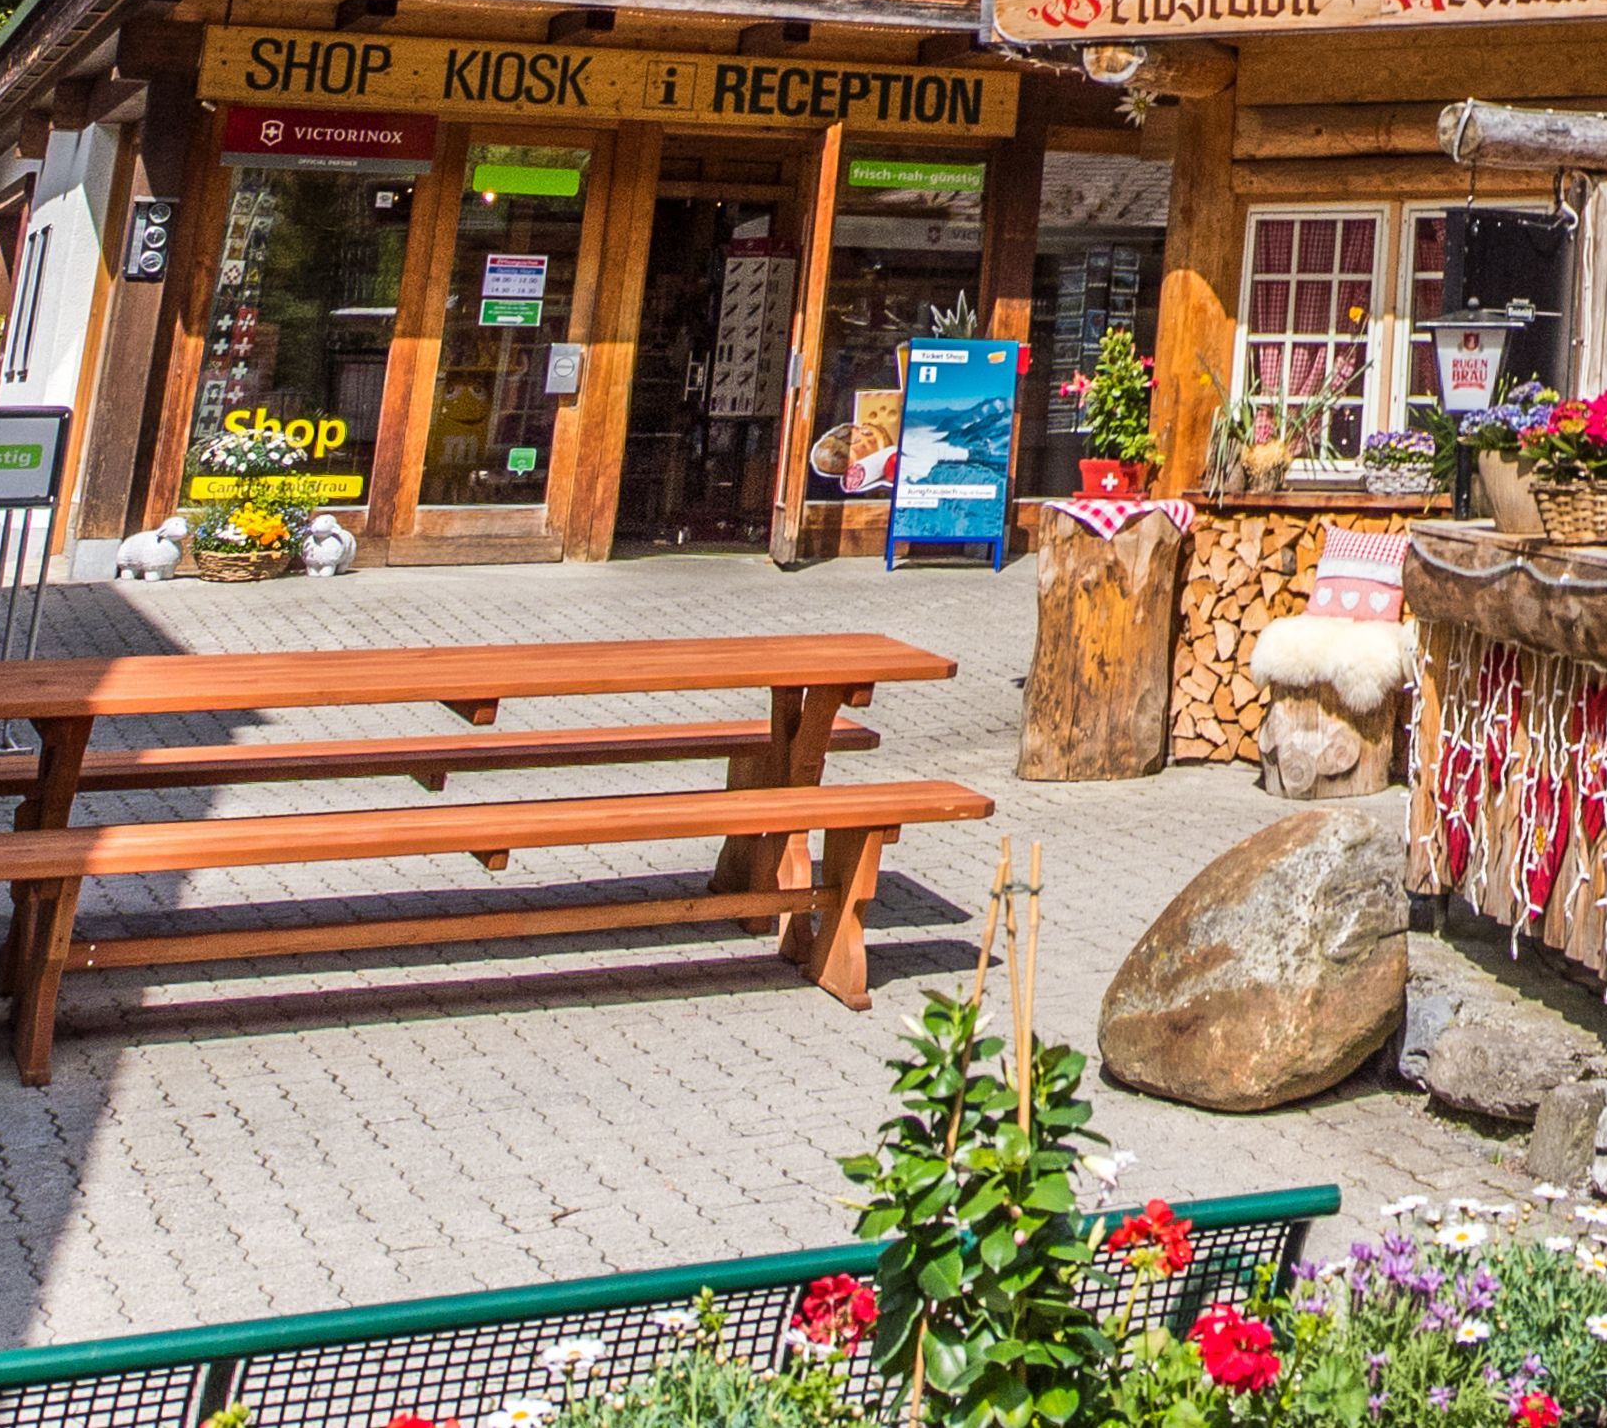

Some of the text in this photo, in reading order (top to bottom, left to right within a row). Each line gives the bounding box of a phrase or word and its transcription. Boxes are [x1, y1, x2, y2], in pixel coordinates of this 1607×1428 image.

[245, 37, 392, 96] SHOP
[443, 49, 593, 106] KIOSK
[711, 63, 983, 125] RECEPTION
[294, 127, 403, 144] VICTORINOX
[224, 408, 347, 459] Shop
